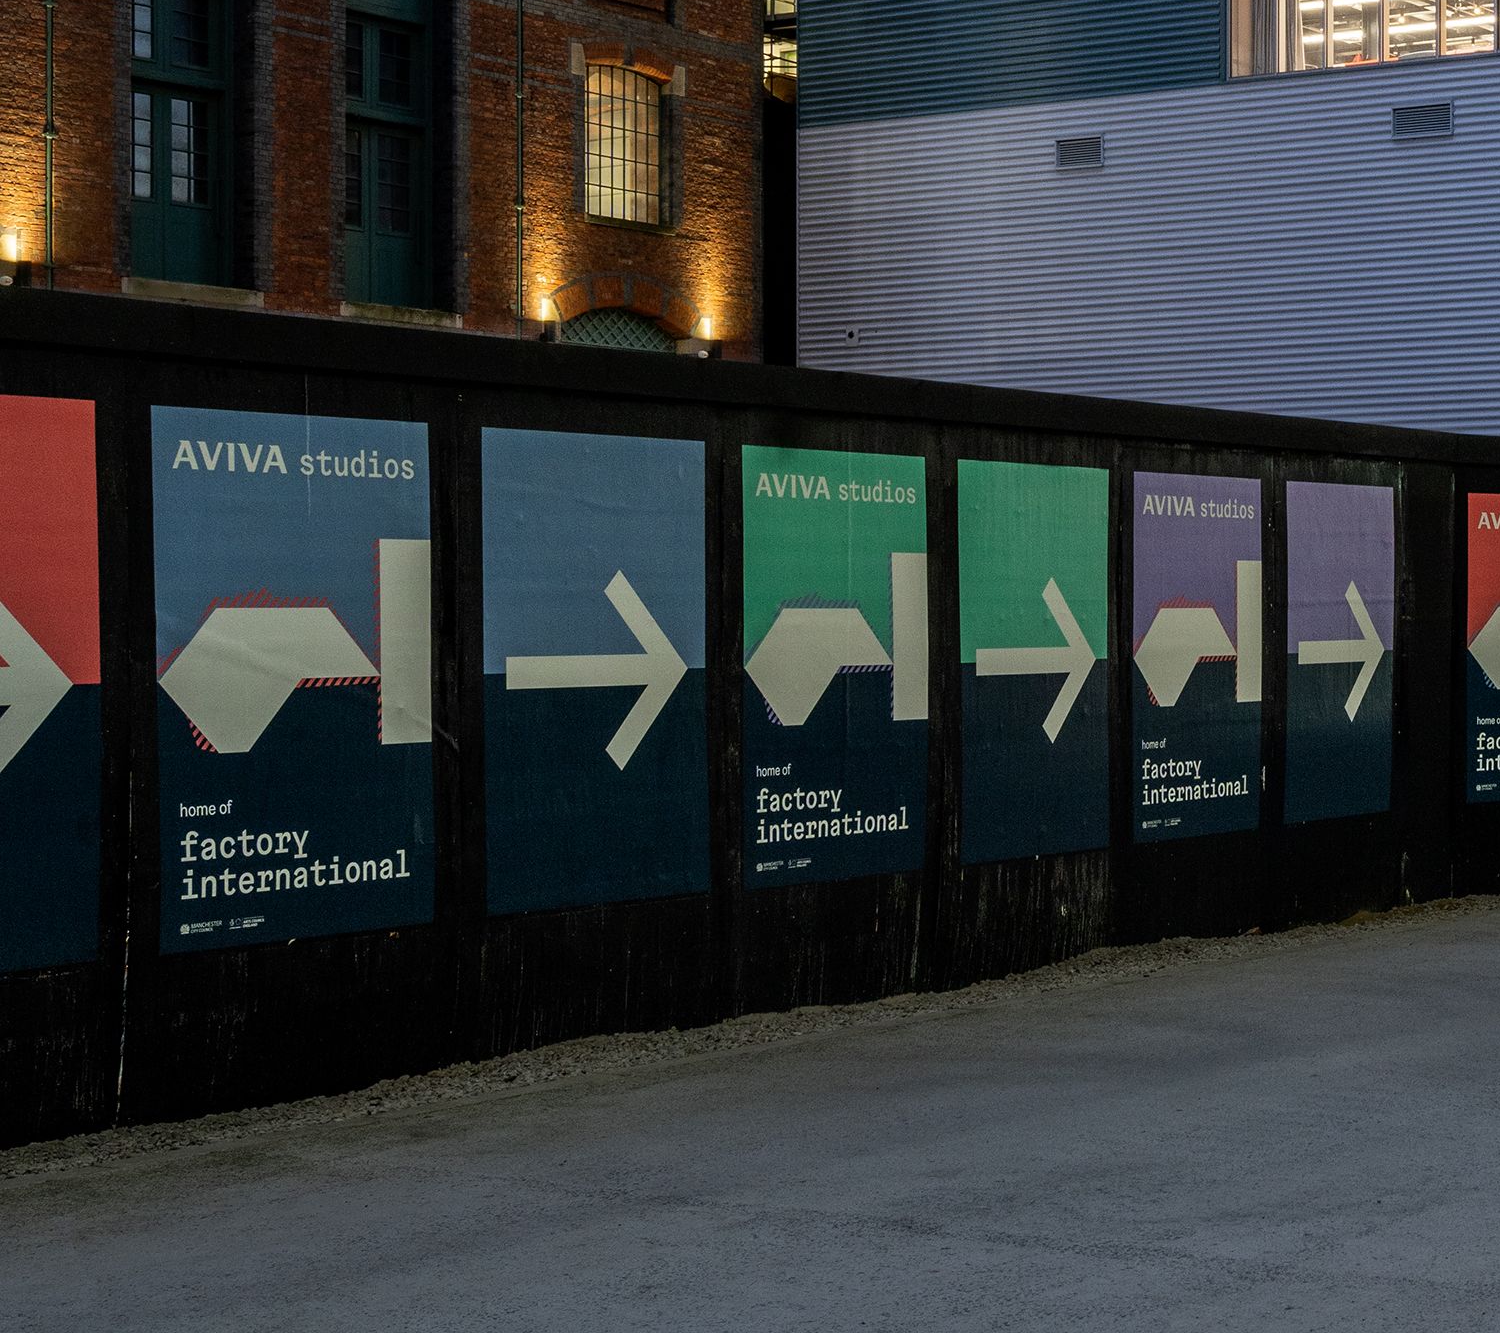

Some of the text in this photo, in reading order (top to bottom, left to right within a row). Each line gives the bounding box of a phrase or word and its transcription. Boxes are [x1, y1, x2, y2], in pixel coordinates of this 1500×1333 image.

[172, 440, 415, 480] AVIVA studios
[755, 472, 916, 504] AVIVA studios
[1142, 494, 1255, 519] AVIVA studios
[1476, 716, 1495, 725] home
[1141, 738, 1167, 750] home of
[756, 763, 792, 777] home of
[1142, 758, 1202, 779] factory
[756, 787, 842, 813] factory
[1142, 774, 1249, 805] international
[180, 800, 233, 818] home of
[756, 806, 909, 844] international
[180, 829, 309, 862] factory
[181, 849, 410, 900] international
[191, 920, 222, 929] MANCHESTER
